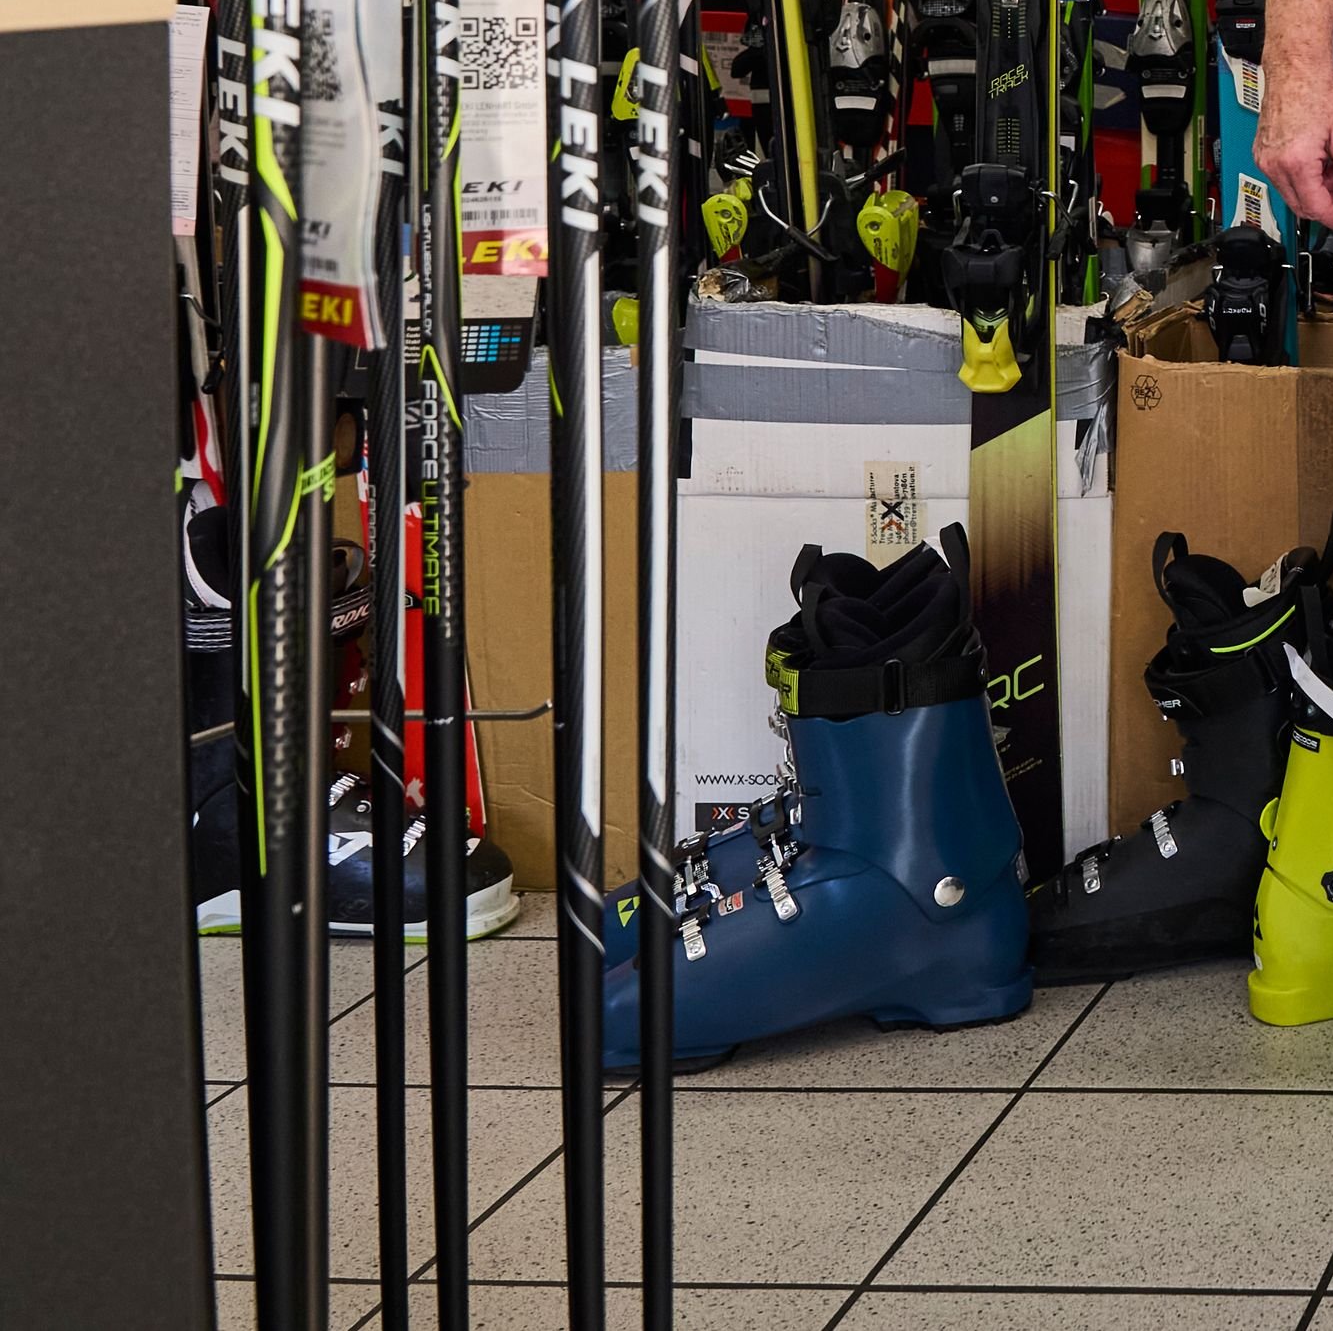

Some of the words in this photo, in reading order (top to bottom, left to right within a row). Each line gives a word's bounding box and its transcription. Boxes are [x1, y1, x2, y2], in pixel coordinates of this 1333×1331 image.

[988, 71, 1029, 100] TRACK
[991, 63, 1026, 88] RACE
[216, 34, 252, 187] LEKI
[556, 57, 600, 232] LEKI
[635, 60, 672, 228] LEKI
[461, 180, 523, 194] EKI
[423, 204, 433, 286] LIGHTWEIGHT
[462, 240, 548, 266] EKI
[301, 292, 354, 328] EKI
[423, 287, 433, 337] ALLOY
[421, 379, 438, 479] FORCE
[421, 480, 440, 616] ULTIMATE
[331, 601, 370, 630] RDIC
[695, 773, 783, 786] WWW.X-SOCK
